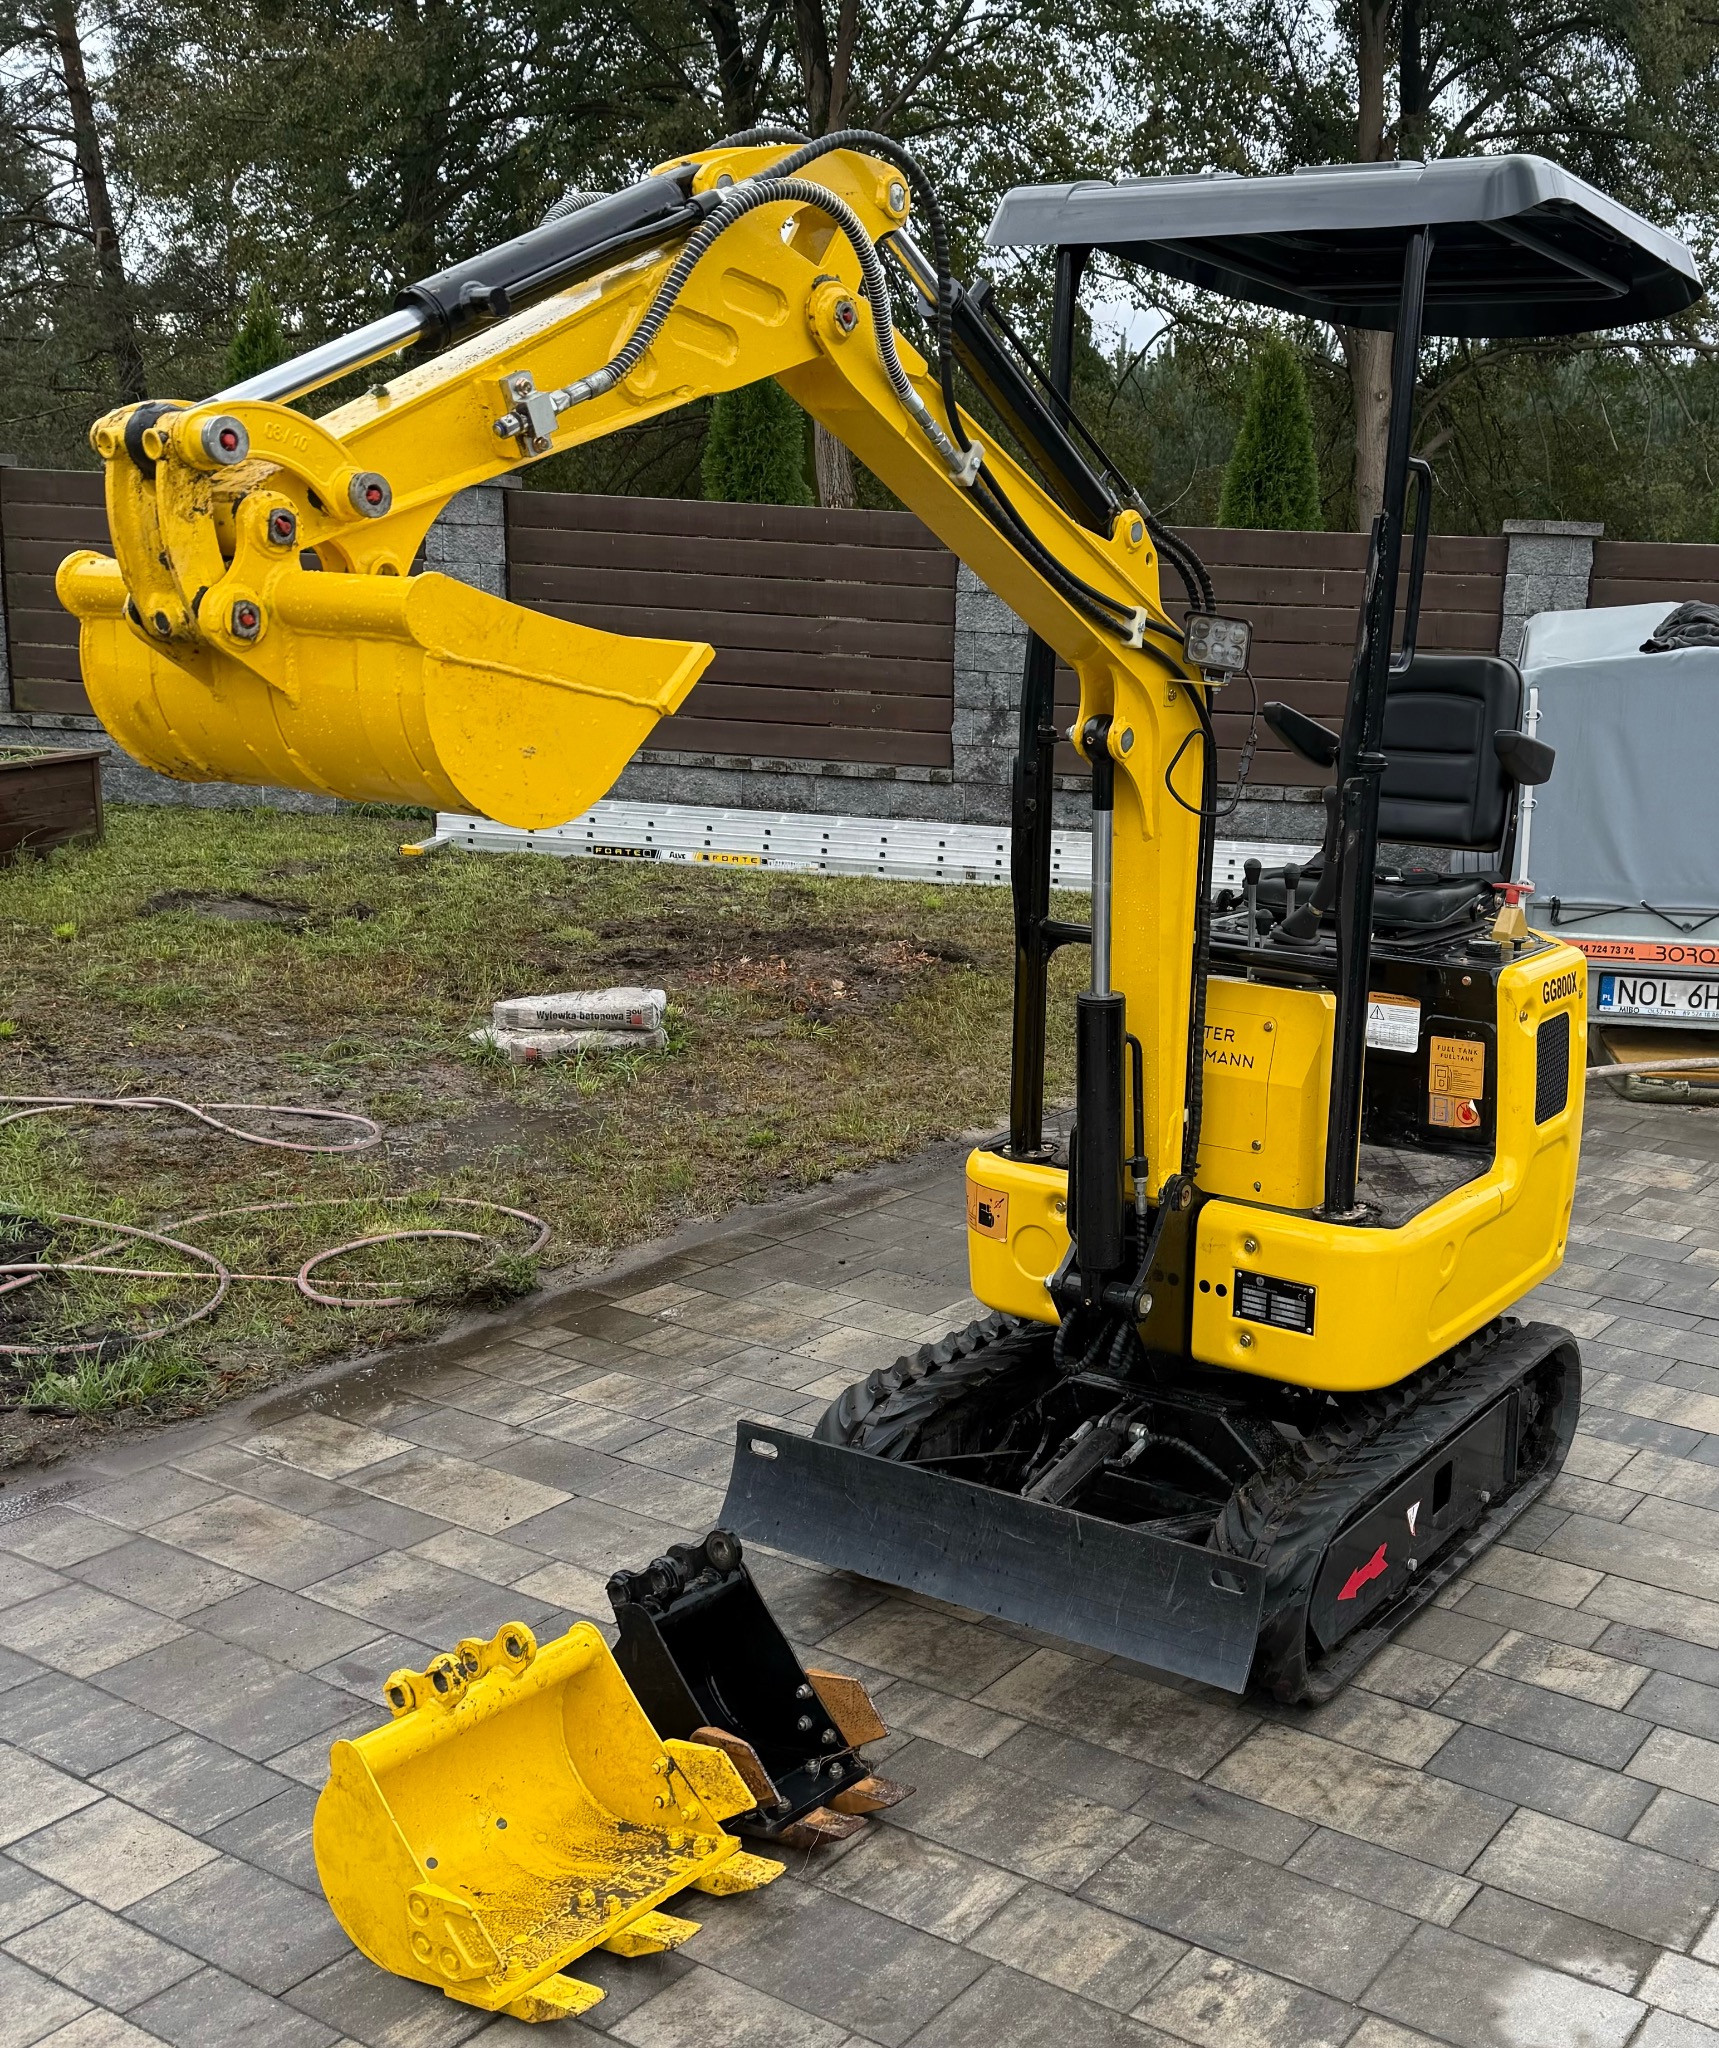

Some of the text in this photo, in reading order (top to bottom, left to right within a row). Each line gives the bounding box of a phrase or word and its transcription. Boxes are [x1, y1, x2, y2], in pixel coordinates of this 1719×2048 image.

[595, 847, 641, 857] FORTE
[712, 855, 758, 864] FORTE
[1591, 945, 1607, 953] 724
[1610, 946, 1621, 954] 73
[1623, 946, 1634, 955] 74
[1542, 971, 1577, 1004] GG800X
[1617, 979, 1676, 1008] NOL
[1602, 993, 1612, 1002] PL
[580, 1011, 624, 1020] betonowa
[1437, 1044, 1478, 1056] FUEL TANK
